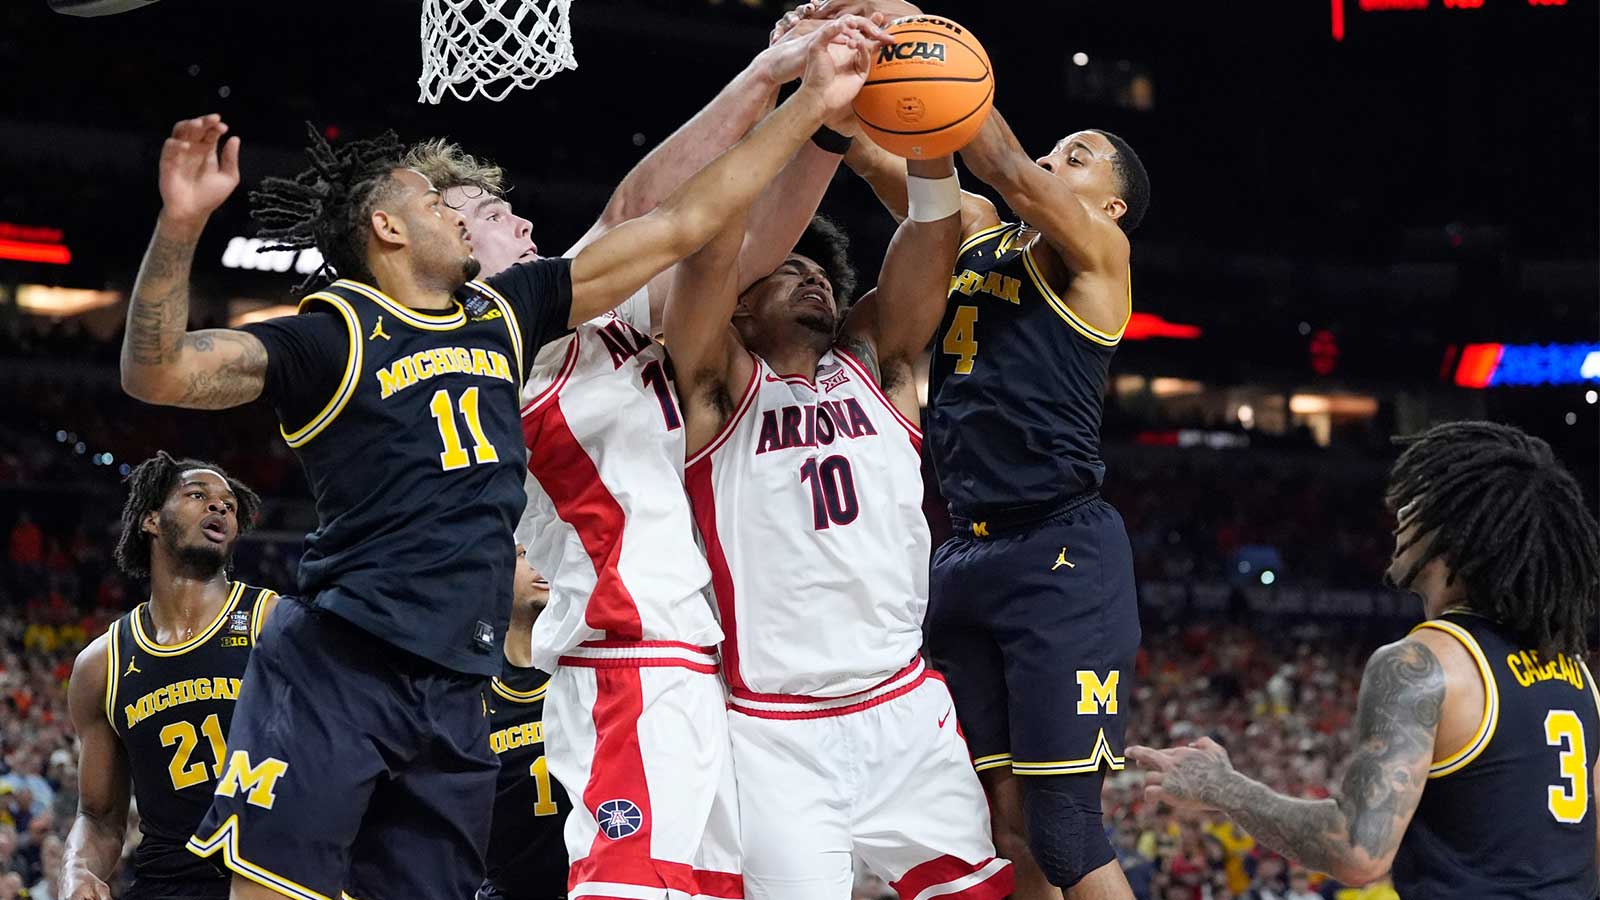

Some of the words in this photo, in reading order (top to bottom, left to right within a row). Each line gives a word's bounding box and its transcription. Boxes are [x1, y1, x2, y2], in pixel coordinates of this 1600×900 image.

[877, 41, 947, 65] NCAA
[943, 305, 979, 375] 4
[376, 347, 514, 400] MICHIGAN
[641, 359, 682, 432] 1
[429, 386, 500, 471] 11
[755, 397, 879, 456] ARIONA
[800, 454, 860, 531] 10
[1075, 670, 1120, 715] M
[159, 713, 228, 791] 21
[214, 750, 289, 810] M
[1543, 709, 1588, 824] 3
[529, 755, 559, 817] 1
